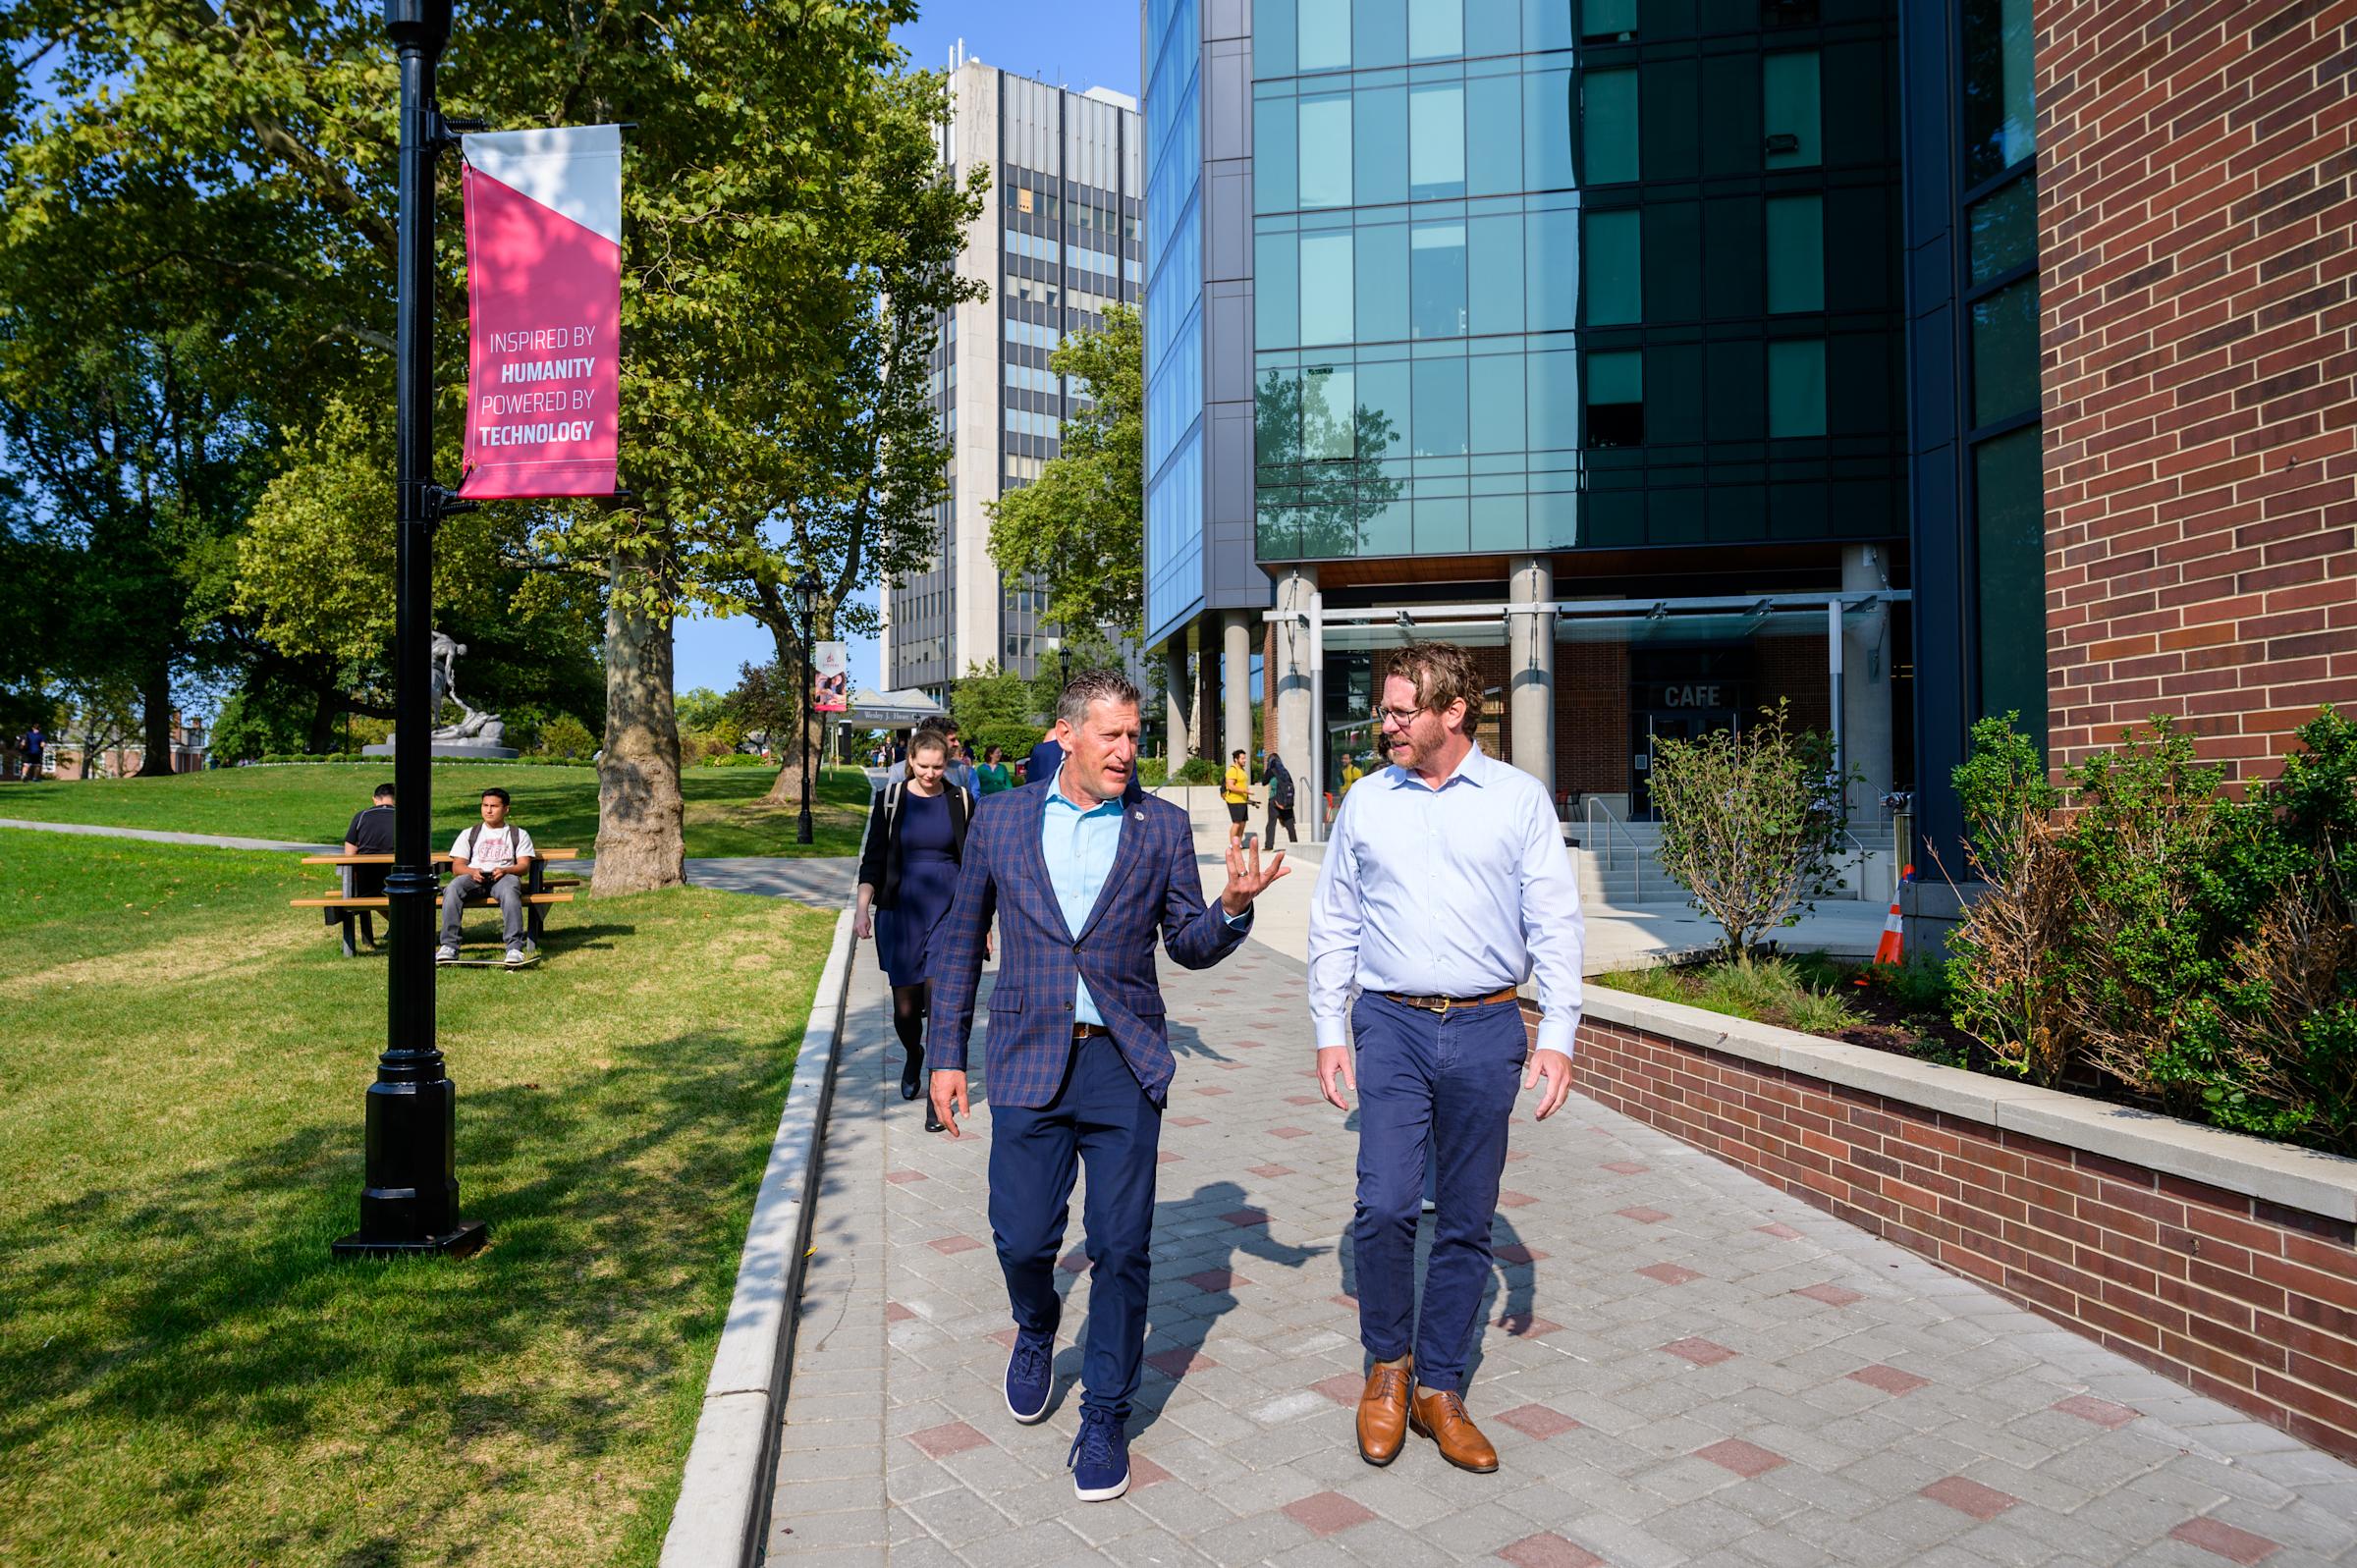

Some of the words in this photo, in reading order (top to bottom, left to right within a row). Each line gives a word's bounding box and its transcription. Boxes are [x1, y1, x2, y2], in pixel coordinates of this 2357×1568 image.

[490, 328, 569, 353] INSPIRED
[574, 325, 596, 347] BY
[502, 357, 595, 384] HUMANITY
[481, 391, 567, 415] POWERED
[573, 389, 595, 409] BY
[479, 420, 594, 447] TECHNOLOGY
[1665, 684, 1721, 707] CAFE
[864, 710, 884, 722] Wesley
